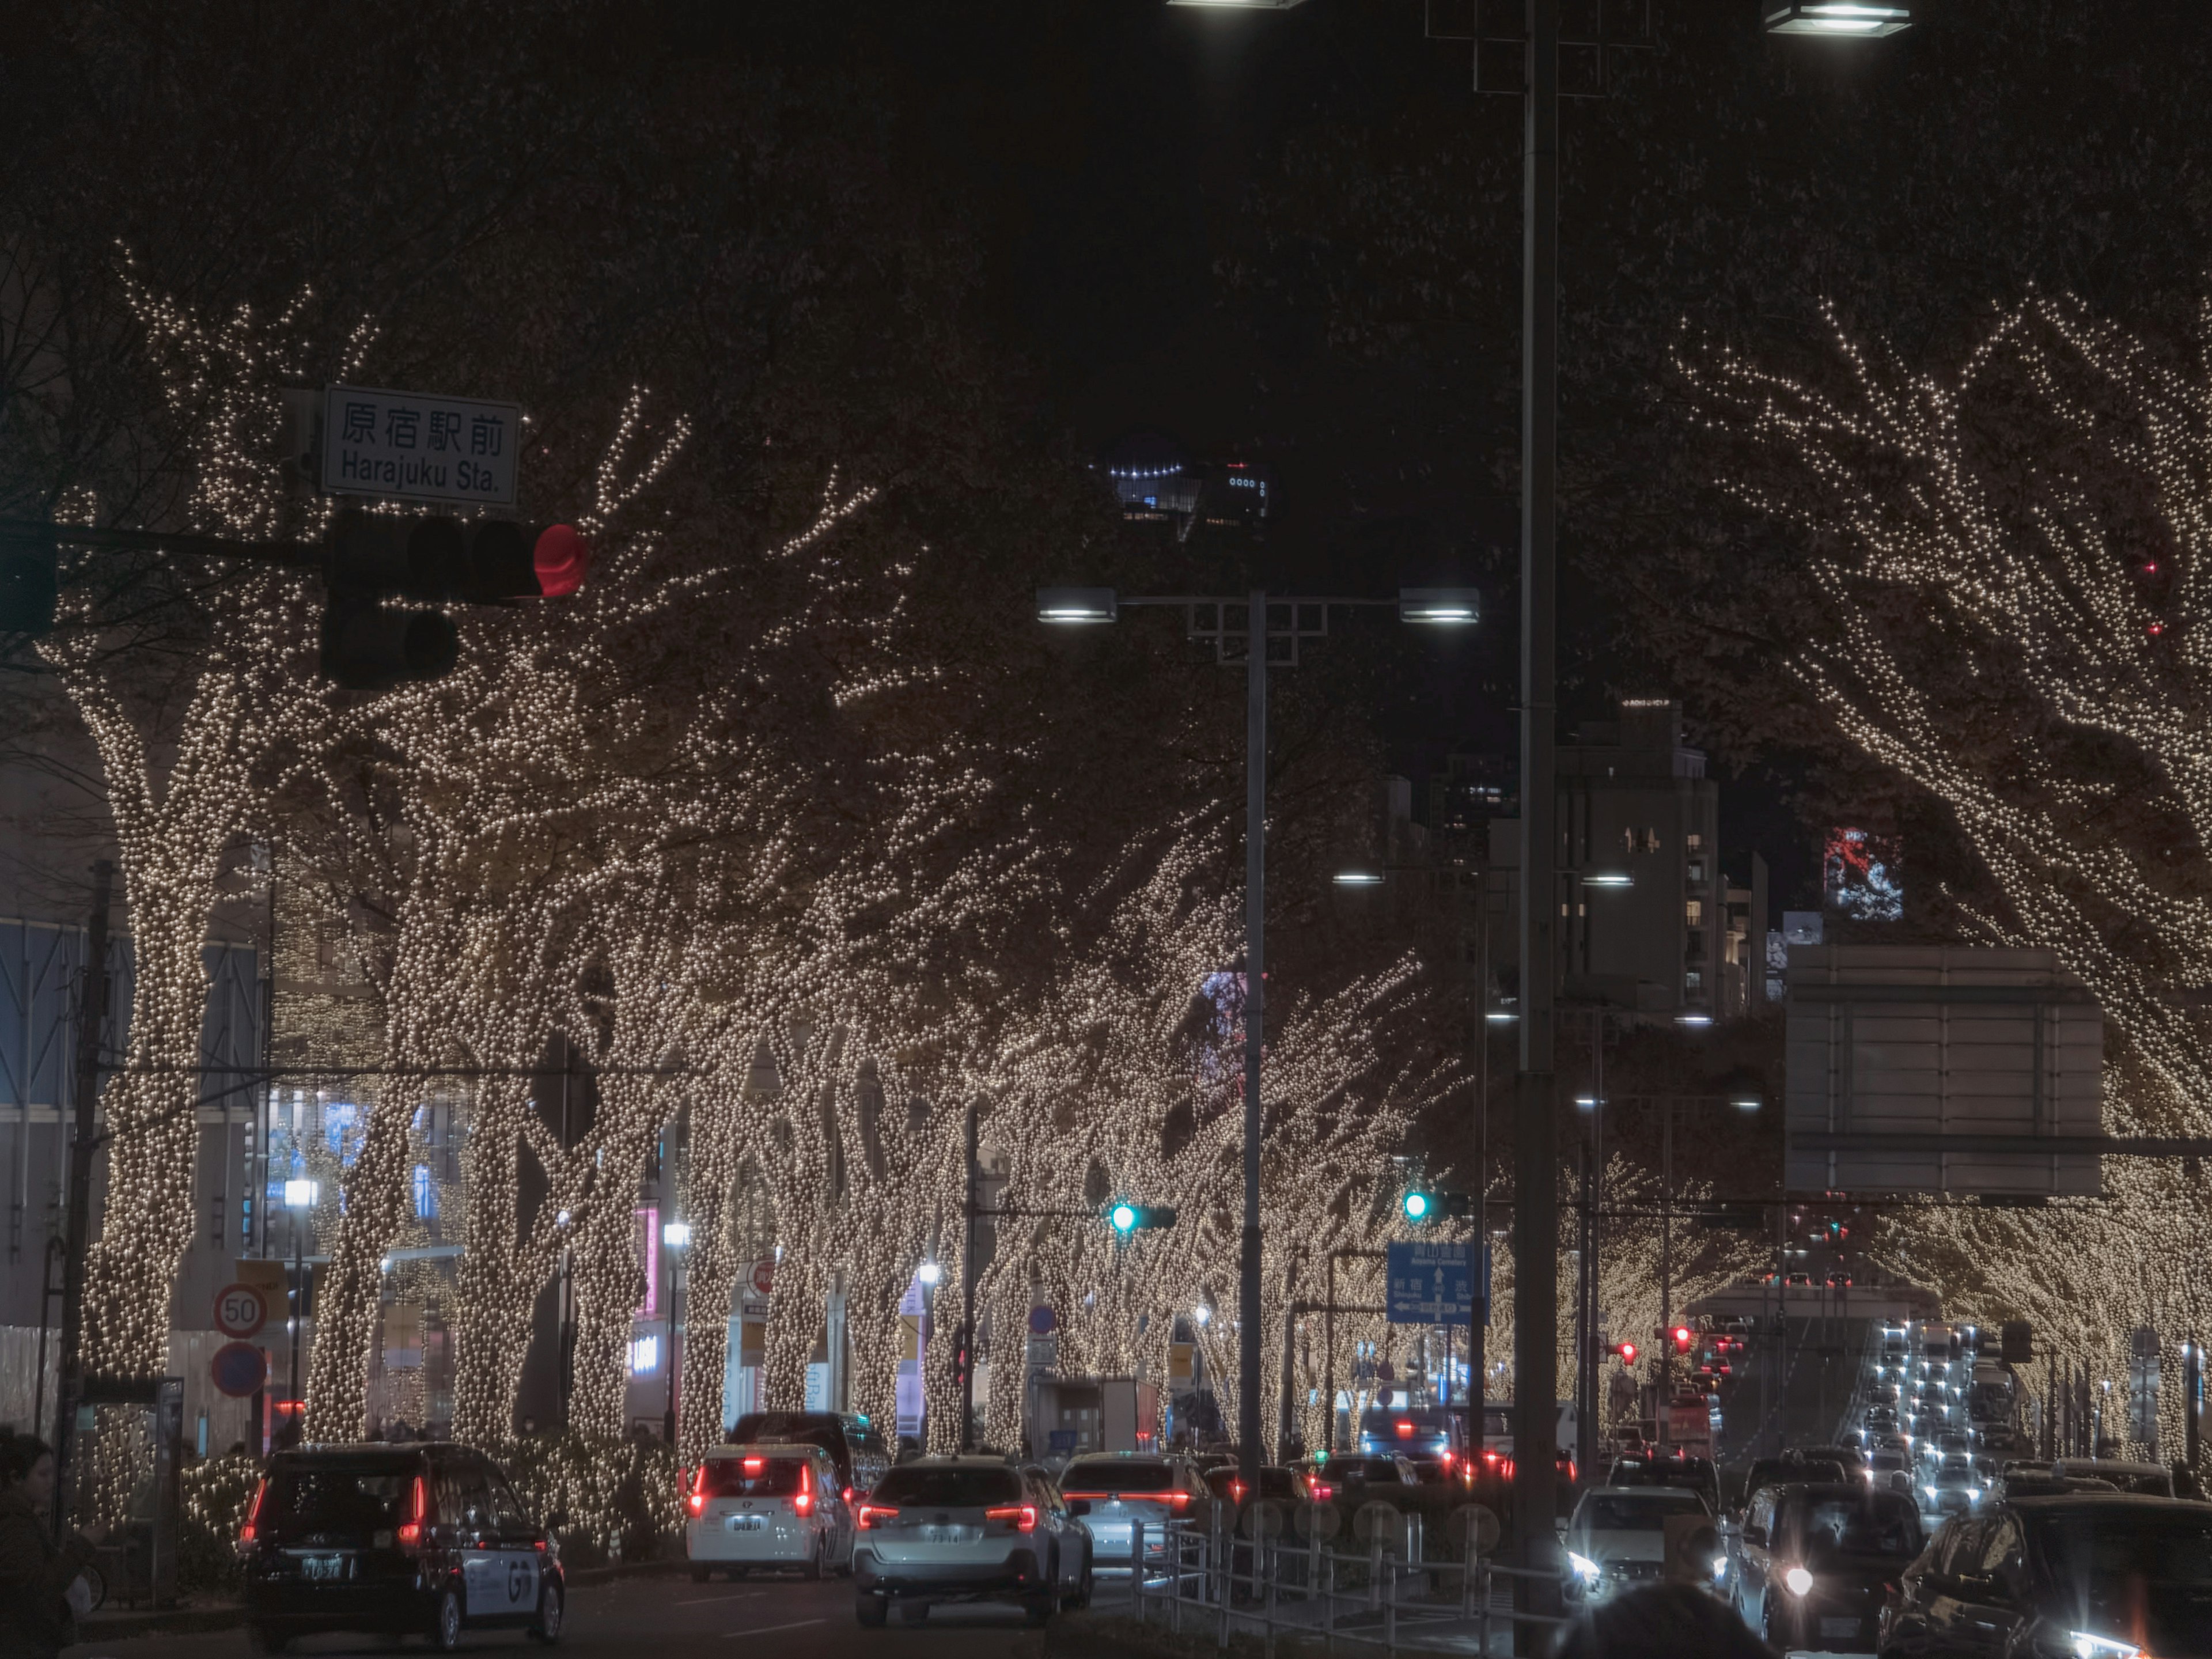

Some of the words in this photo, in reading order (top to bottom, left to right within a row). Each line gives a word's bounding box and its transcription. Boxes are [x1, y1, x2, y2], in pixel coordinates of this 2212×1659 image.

[342, 403, 504, 457] 原宿駅前
[342, 449, 446, 490] Harajuku
[457, 460, 499, 493] Sta.
[1411, 1257, 1436, 1266] Aoyama
[1393, 1278, 1423, 1290] 新宿
[1394, 1290, 1422, 1299] Shinjuku
[225, 1298, 255, 1323] 50
